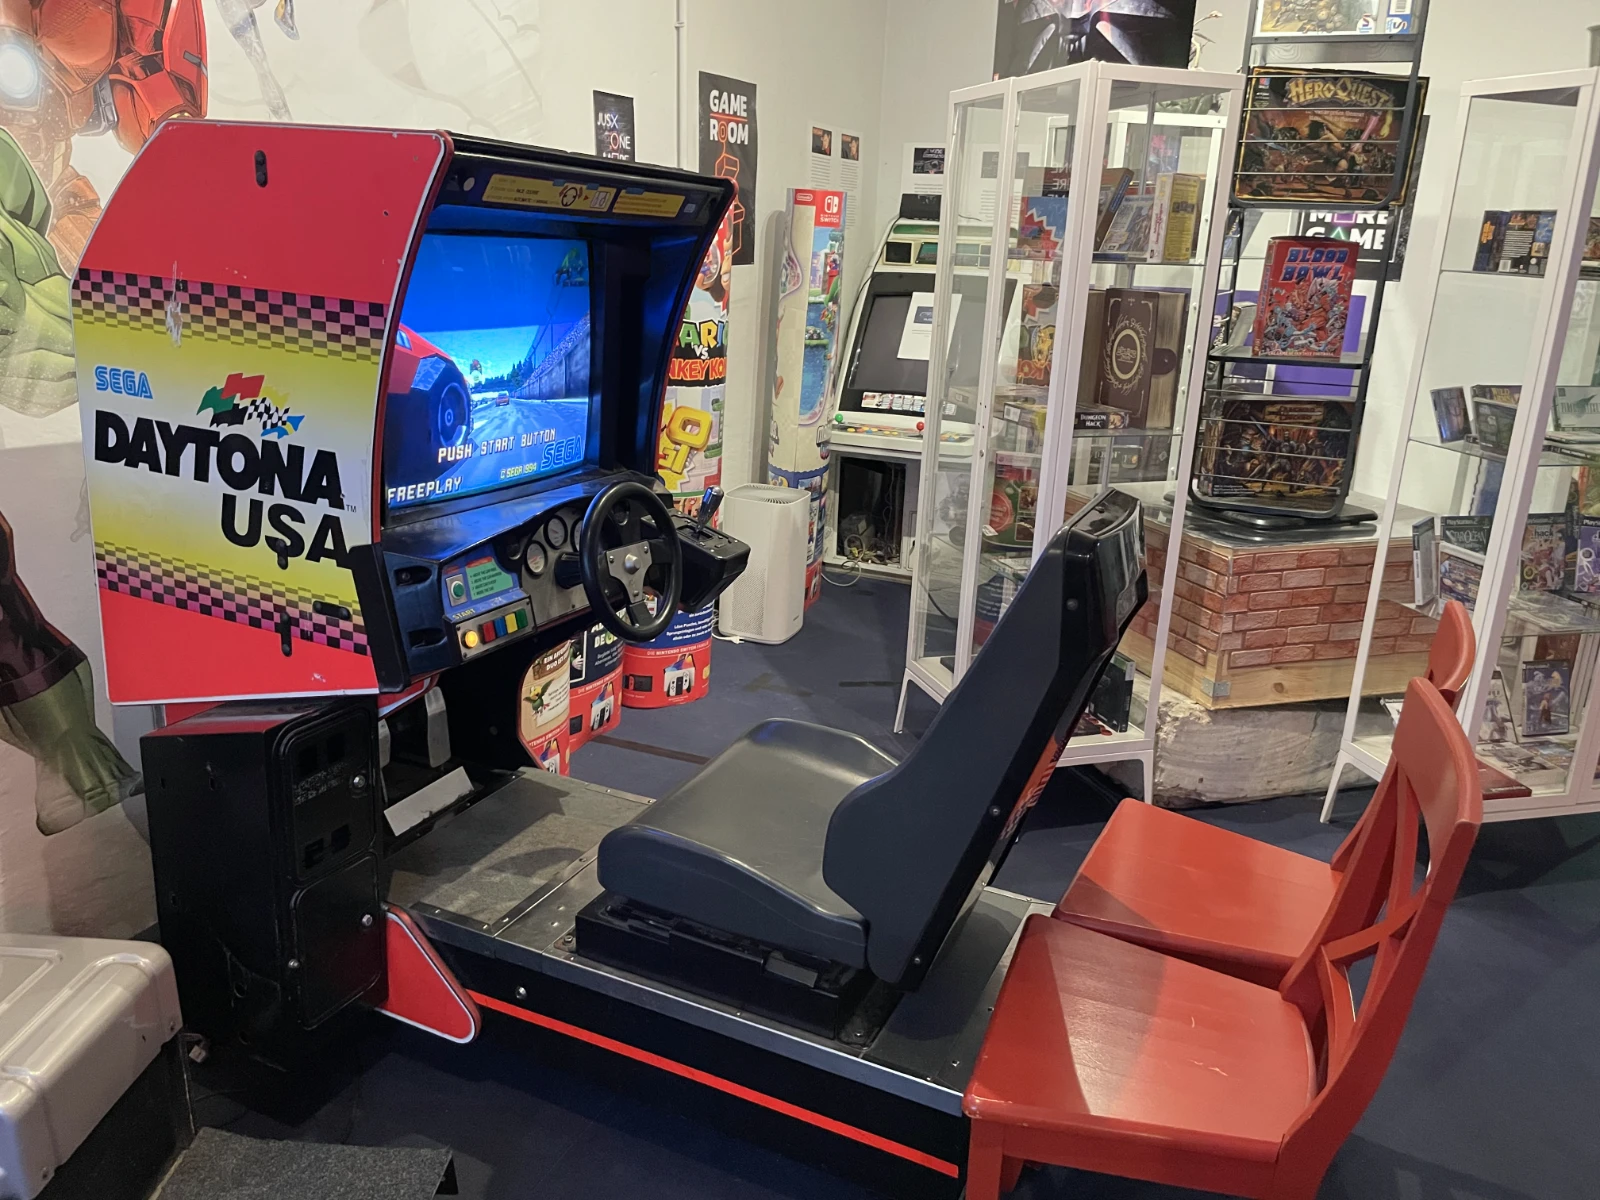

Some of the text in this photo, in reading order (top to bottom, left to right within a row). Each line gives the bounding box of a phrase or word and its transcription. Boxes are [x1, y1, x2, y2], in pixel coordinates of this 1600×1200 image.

[709, 89, 748, 118] GAME
[610, 133, 631, 150] ONE
[709, 118, 749, 145] ROOM
[1286, 247, 1350, 264] BLOOD
[1279, 264, 1344, 282] BOWL
[679, 320, 729, 348] ARI
[95, 365, 153, 400] SEGA
[669, 358, 709, 381] NKEY
[438, 428, 556, 463] PUSH START BUTTON
[541, 435, 583, 471] SEGA
[95, 409, 345, 511] DAYTONA
[388, 476, 463, 504] FREEPLAY
[220, 493, 353, 570] USA
[452, 608, 476, 620] START
[656, 648, 680, 656] NINTENDO
